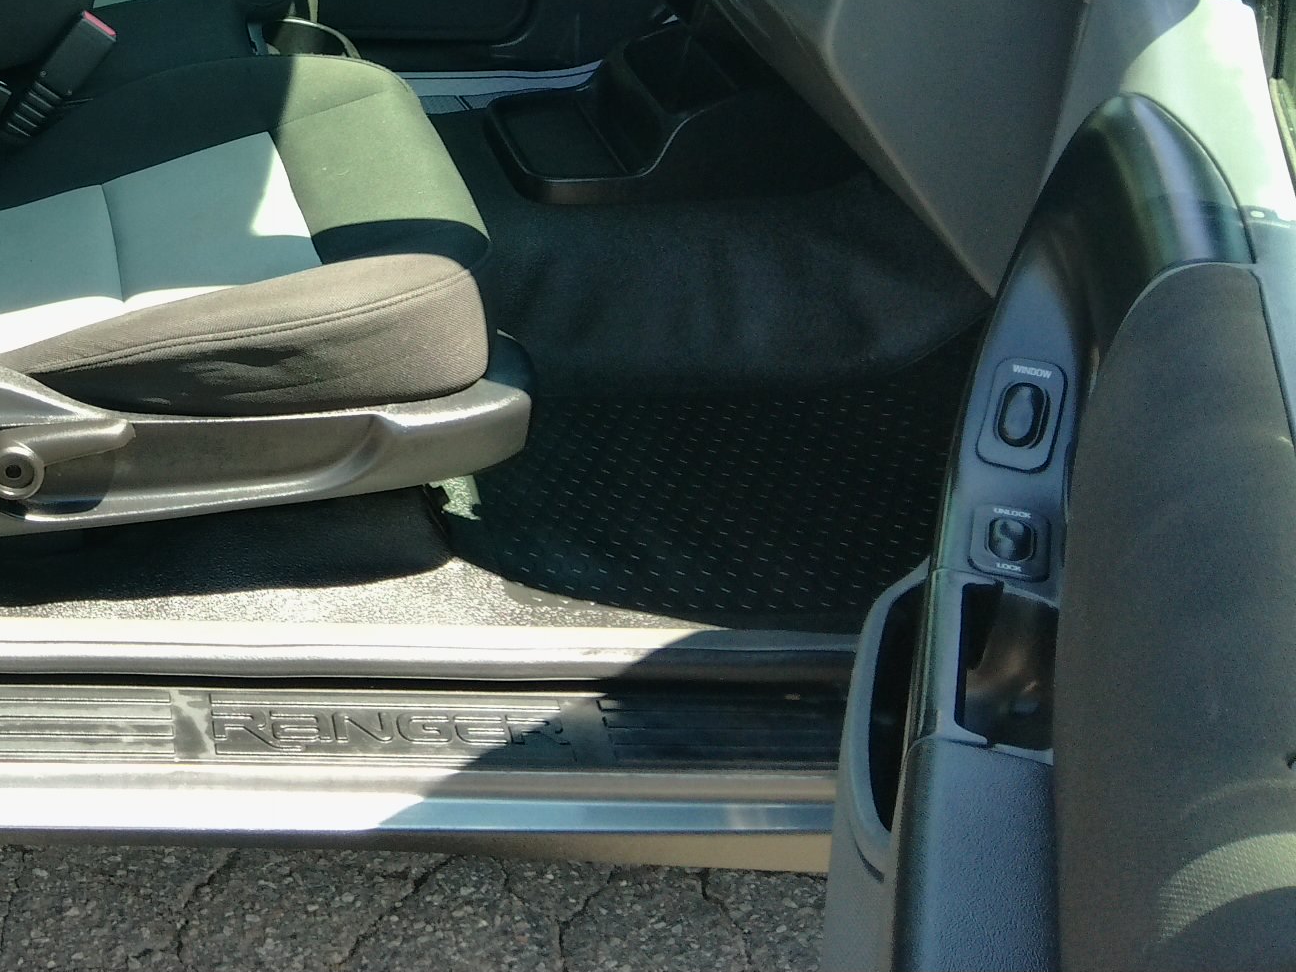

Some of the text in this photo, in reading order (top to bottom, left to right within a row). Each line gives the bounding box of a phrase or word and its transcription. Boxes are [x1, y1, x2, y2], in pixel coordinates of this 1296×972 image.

[1012, 364, 1052, 378] WINDOW
[993, 507, 1032, 519] UNLOCK
[995, 562, 1022, 573] LOCK
[211, 710, 572, 752] RANGER
